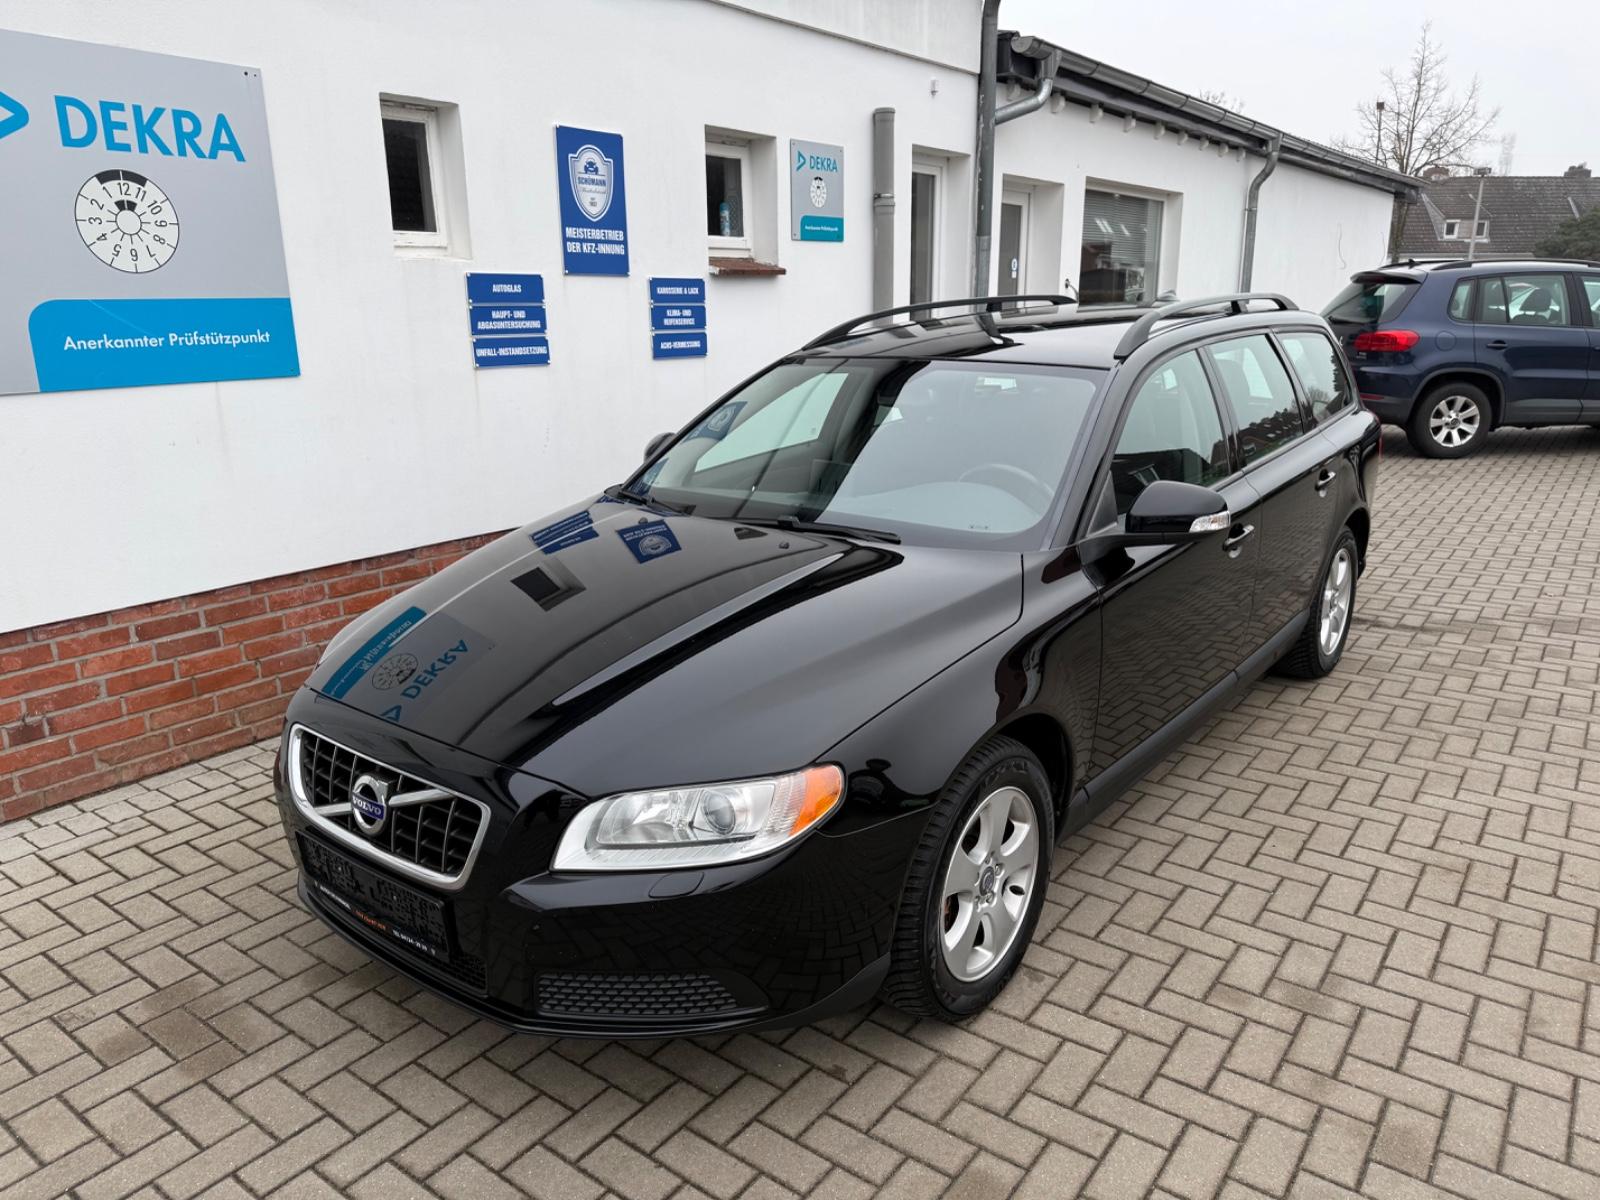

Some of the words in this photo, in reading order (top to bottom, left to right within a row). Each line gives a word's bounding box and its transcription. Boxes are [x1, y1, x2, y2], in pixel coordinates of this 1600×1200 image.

[54, 95, 246, 162] DEKRA
[809, 155, 838, 172] DEKRA
[102, 186, 113, 199] 1
[117, 182, 131, 196] 12
[135, 187, 147, 202] 11
[90, 198, 104, 210] 2
[147, 200, 162, 215] 10
[88, 217, 103, 225] 3
[96, 233, 108, 242] 4
[153, 234, 166, 245] 8
[565, 227, 624, 241] MEISTERBETRIEB
[112, 244, 122, 257] 5
[146, 245, 156, 258] 7
[566, 242, 581, 253] DER
[582, 242, 625, 255] KFZ-INNUNG
[492, 284, 522, 293] AUTOGLAS
[491, 310, 513, 319] HAUPT-
[513, 310, 526, 319] UND
[477, 320, 541, 329] ABGASUNTERSUCHUNG
[63, 333, 165, 351] Anerkannter
[169, 329, 271, 348] Prüfstützpunkt
[476, 345, 548, 358] UNFALL-INSTANDSETZUNG
[352, 794, 382, 816] VOLVO
